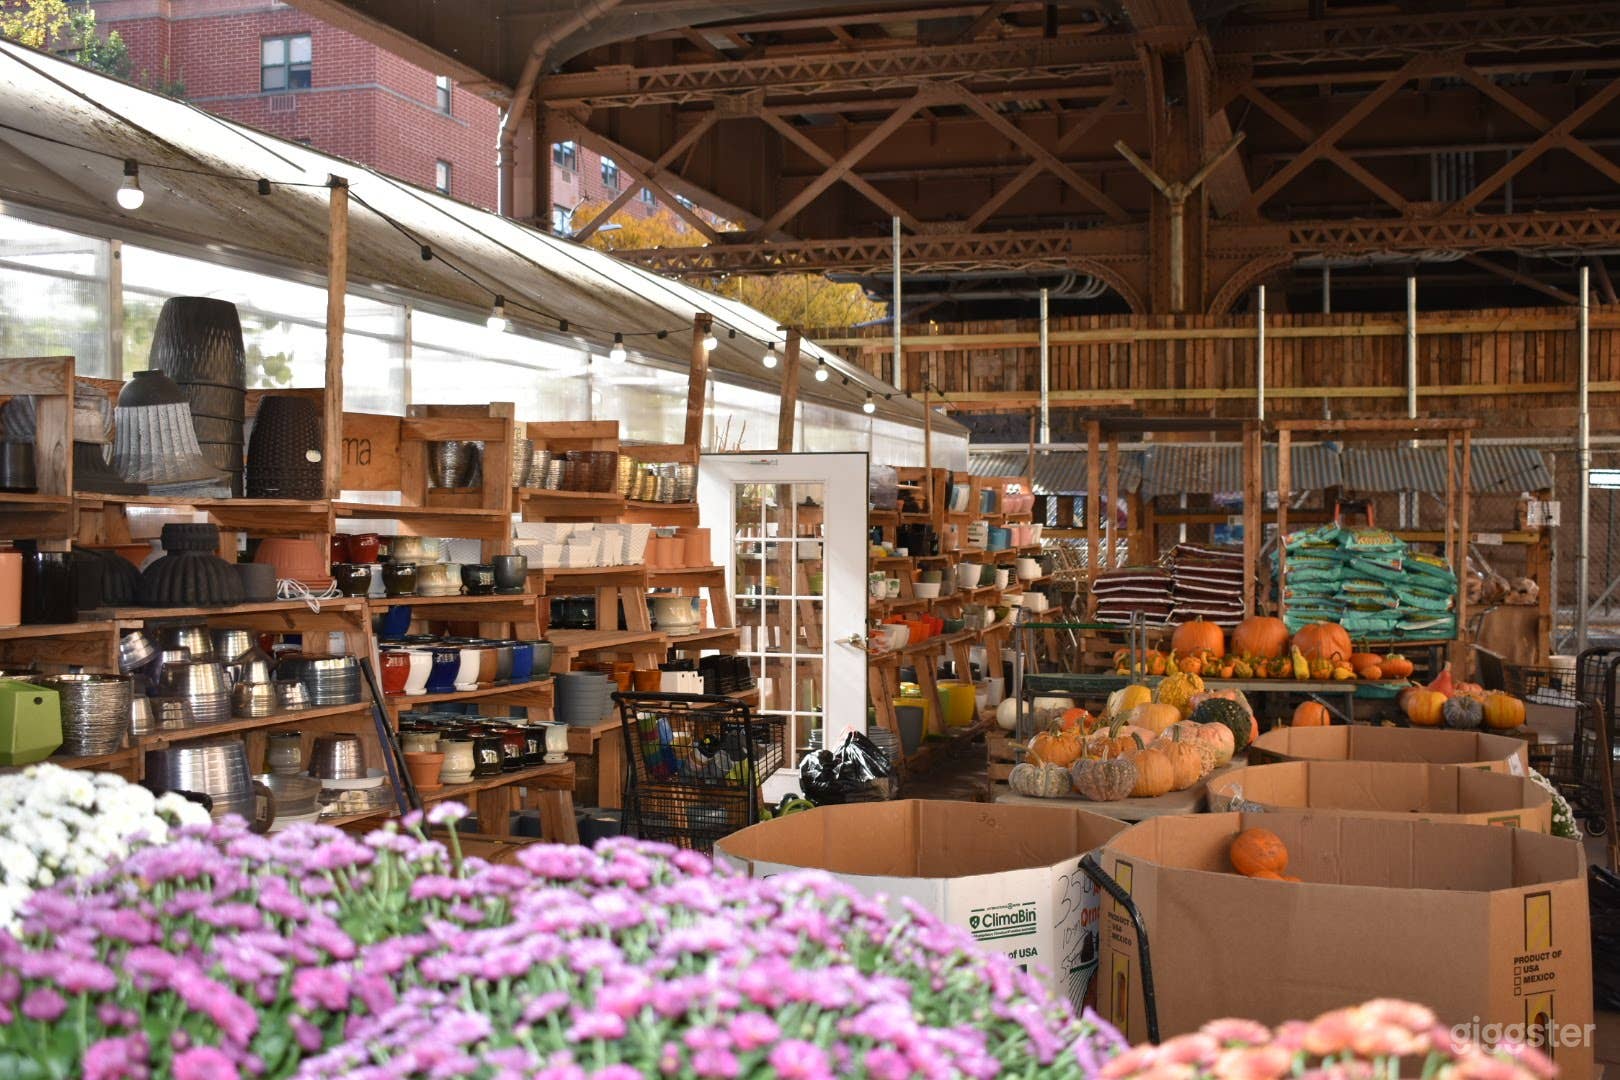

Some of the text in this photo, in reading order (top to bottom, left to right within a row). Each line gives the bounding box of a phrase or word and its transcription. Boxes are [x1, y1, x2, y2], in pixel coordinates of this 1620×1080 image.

[982, 909, 1037, 928] ClimaBin
[1008, 947, 1038, 959] of USA
[1513, 949, 1562, 965] PRODUCT OF
[1523, 964, 1540, 974] USA
[1523, 972, 1556, 984] MEXICO
